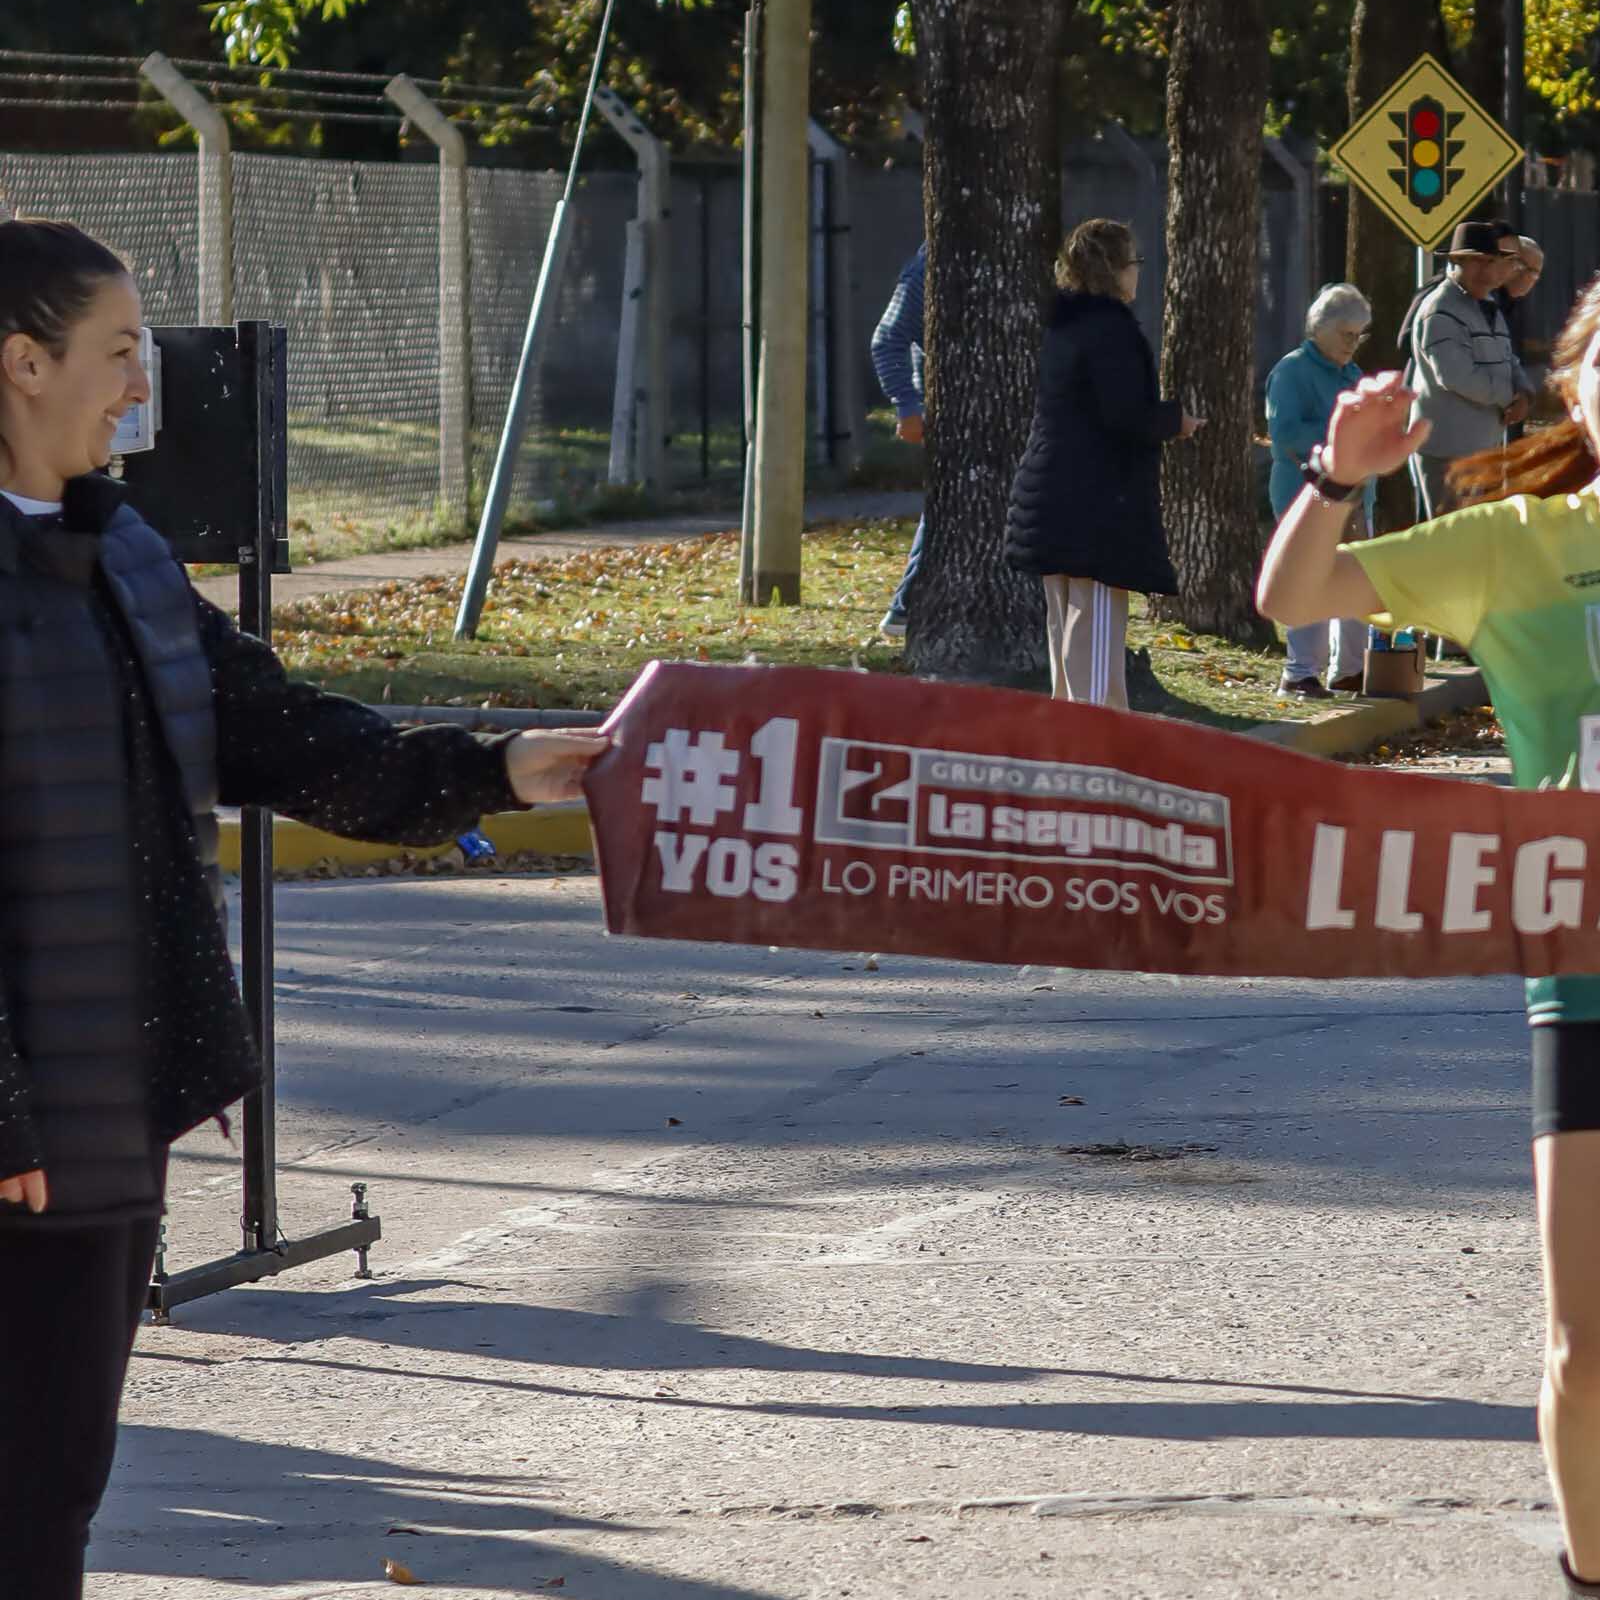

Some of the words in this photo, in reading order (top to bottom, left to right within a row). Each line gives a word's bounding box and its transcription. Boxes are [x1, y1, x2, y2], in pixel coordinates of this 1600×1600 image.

[641, 717, 802, 835] #1
[931, 761, 1025, 787] GRUPO
[1031, 772, 1216, 820] ASEGURADOR
[654, 830, 799, 903] VOS
[822, 857, 877, 895] LO
[887, 864, 1054, 910] PRIMERO
[1065, 877, 1141, 915] SOS
[1150, 883, 1227, 925] VOS
